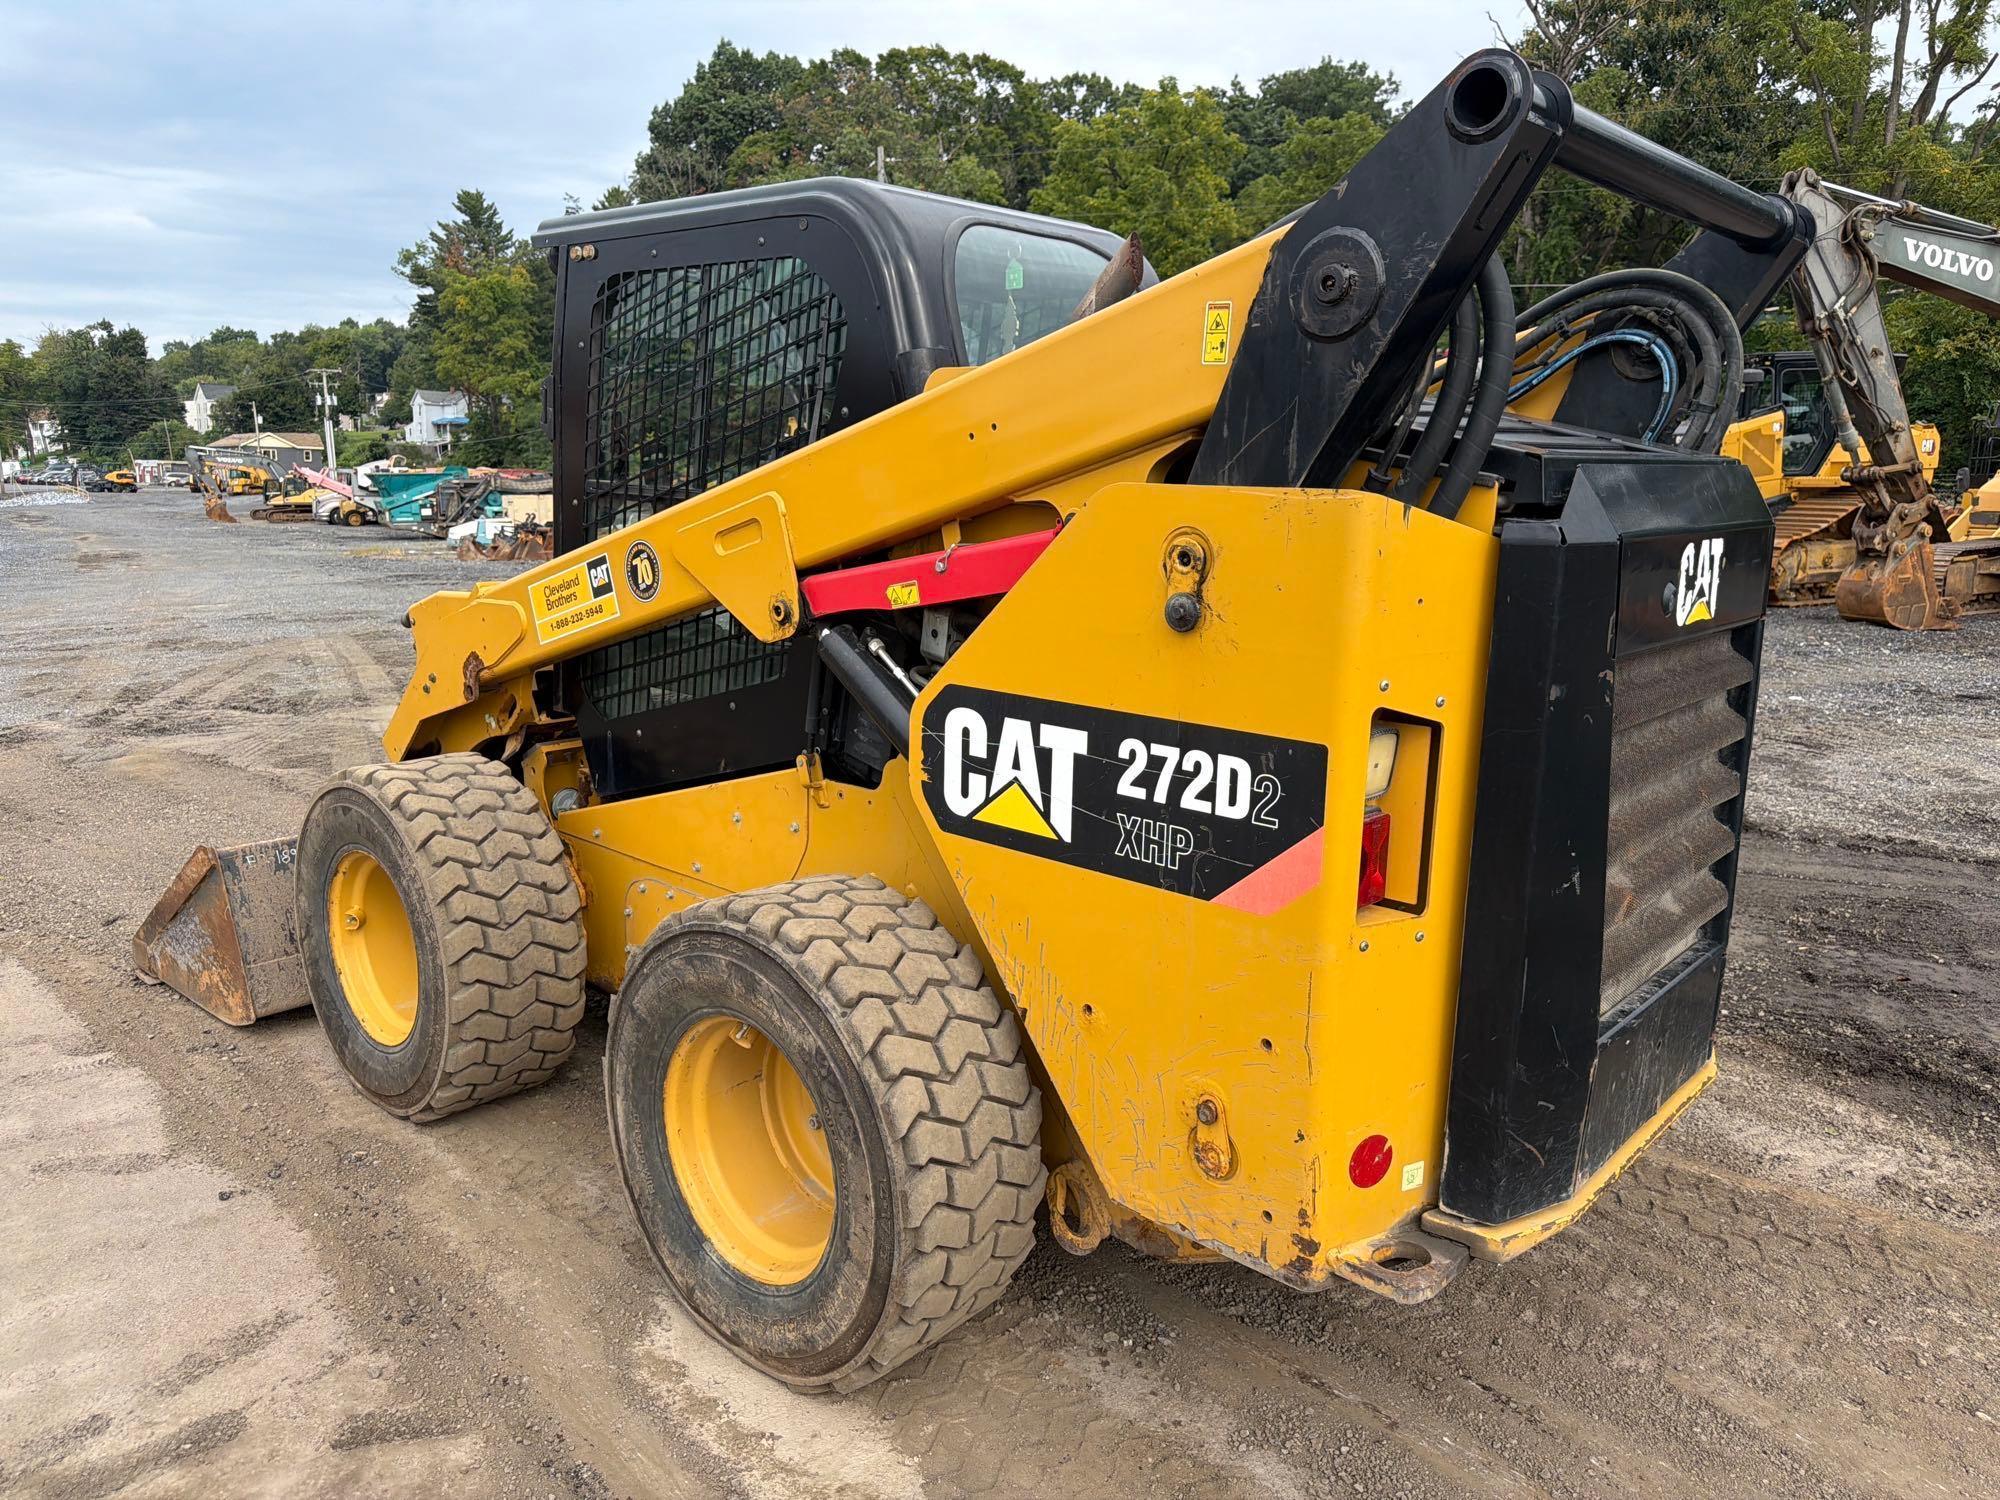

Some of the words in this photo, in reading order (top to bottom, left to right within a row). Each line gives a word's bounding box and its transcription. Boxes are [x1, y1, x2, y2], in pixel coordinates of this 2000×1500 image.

[1903, 236, 1994, 282] VOLVO
[1921, 439, 1934, 453] CAT
[216, 456, 244, 464] VOLVO
[543, 573, 580, 599] Cleveland
[590, 564, 609, 588] CAT
[1676, 537, 1724, 627] CAT
[546, 591, 578, 611] Brothers
[550, 604, 604, 632] 1-888-232-5948
[943, 706, 1089, 844] CAT
[1114, 813, 1194, 870] XHP
